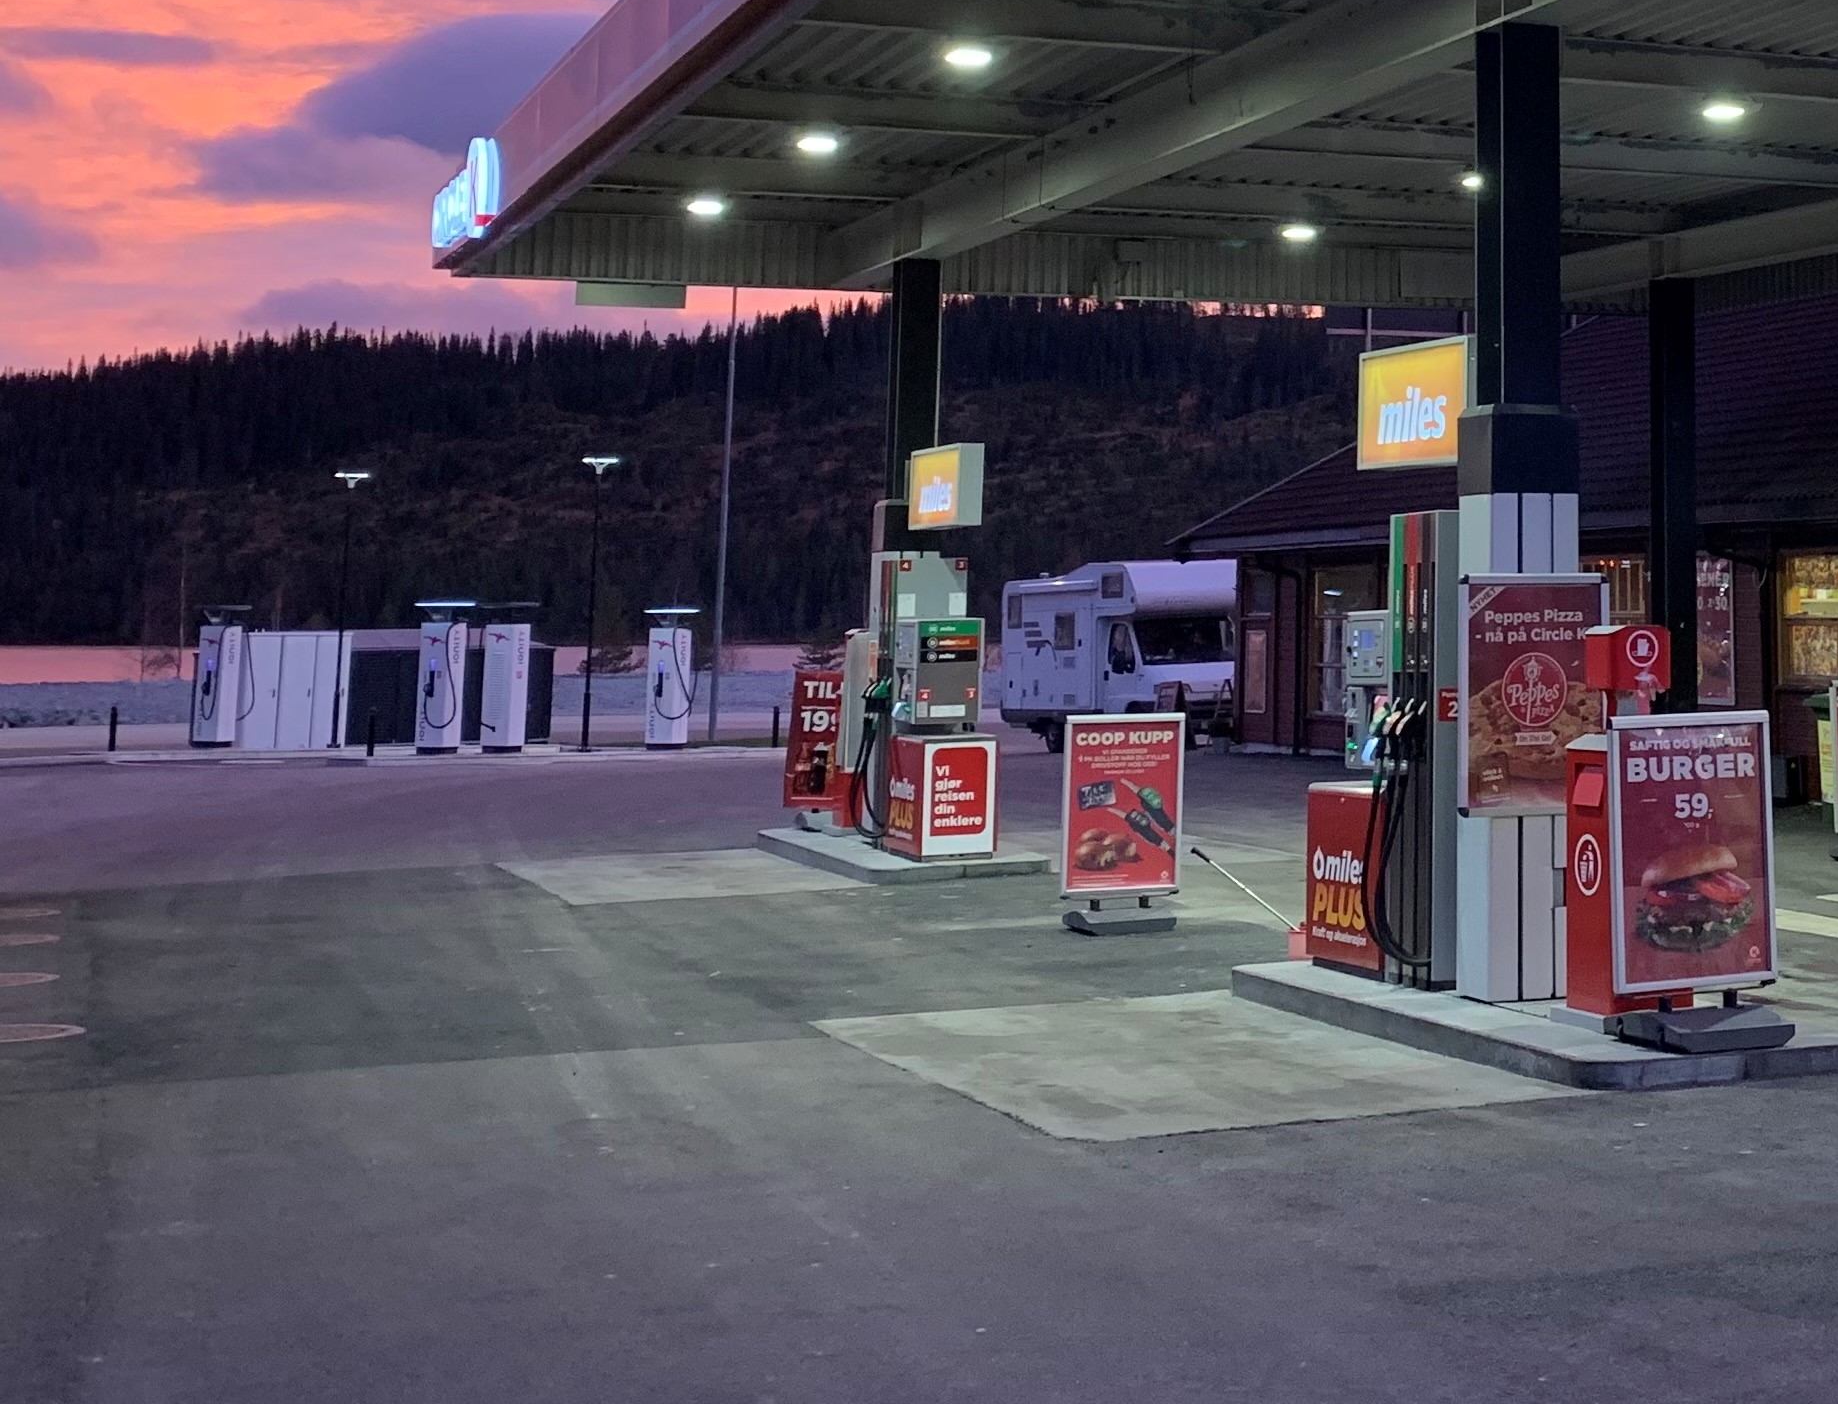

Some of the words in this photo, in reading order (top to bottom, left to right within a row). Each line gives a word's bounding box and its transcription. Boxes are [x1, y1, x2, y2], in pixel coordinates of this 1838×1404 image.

[1377, 385, 1447, 445] miles
[902, 561, 909, 569] 4
[1470, 587, 1498, 612] NYHET
[1484, 610, 1540, 626] Peppes
[1544, 608, 1584, 623] Pizza
[1485, 626, 1504, 643] nå
[1507, 625, 1527, 645] på
[1530, 626, 1574, 642] Circle
[1506, 682, 1560, 708] Peppes
[1447, 700, 1459, 718] 2
[1076, 731, 1125, 746] COOP
[1128, 730, 1174, 745] KUPP
[1629, 739, 1671, 751] SAFTIG
[1672, 738, 1690, 750] OG
[1626, 752, 1756, 783] BURGER
[935, 778, 963, 792] gjør
[934, 791, 975, 802] reisen
[934, 803, 956, 815] din
[933, 815, 983, 828] enklere
[1312, 882, 1366, 931] PLUS
